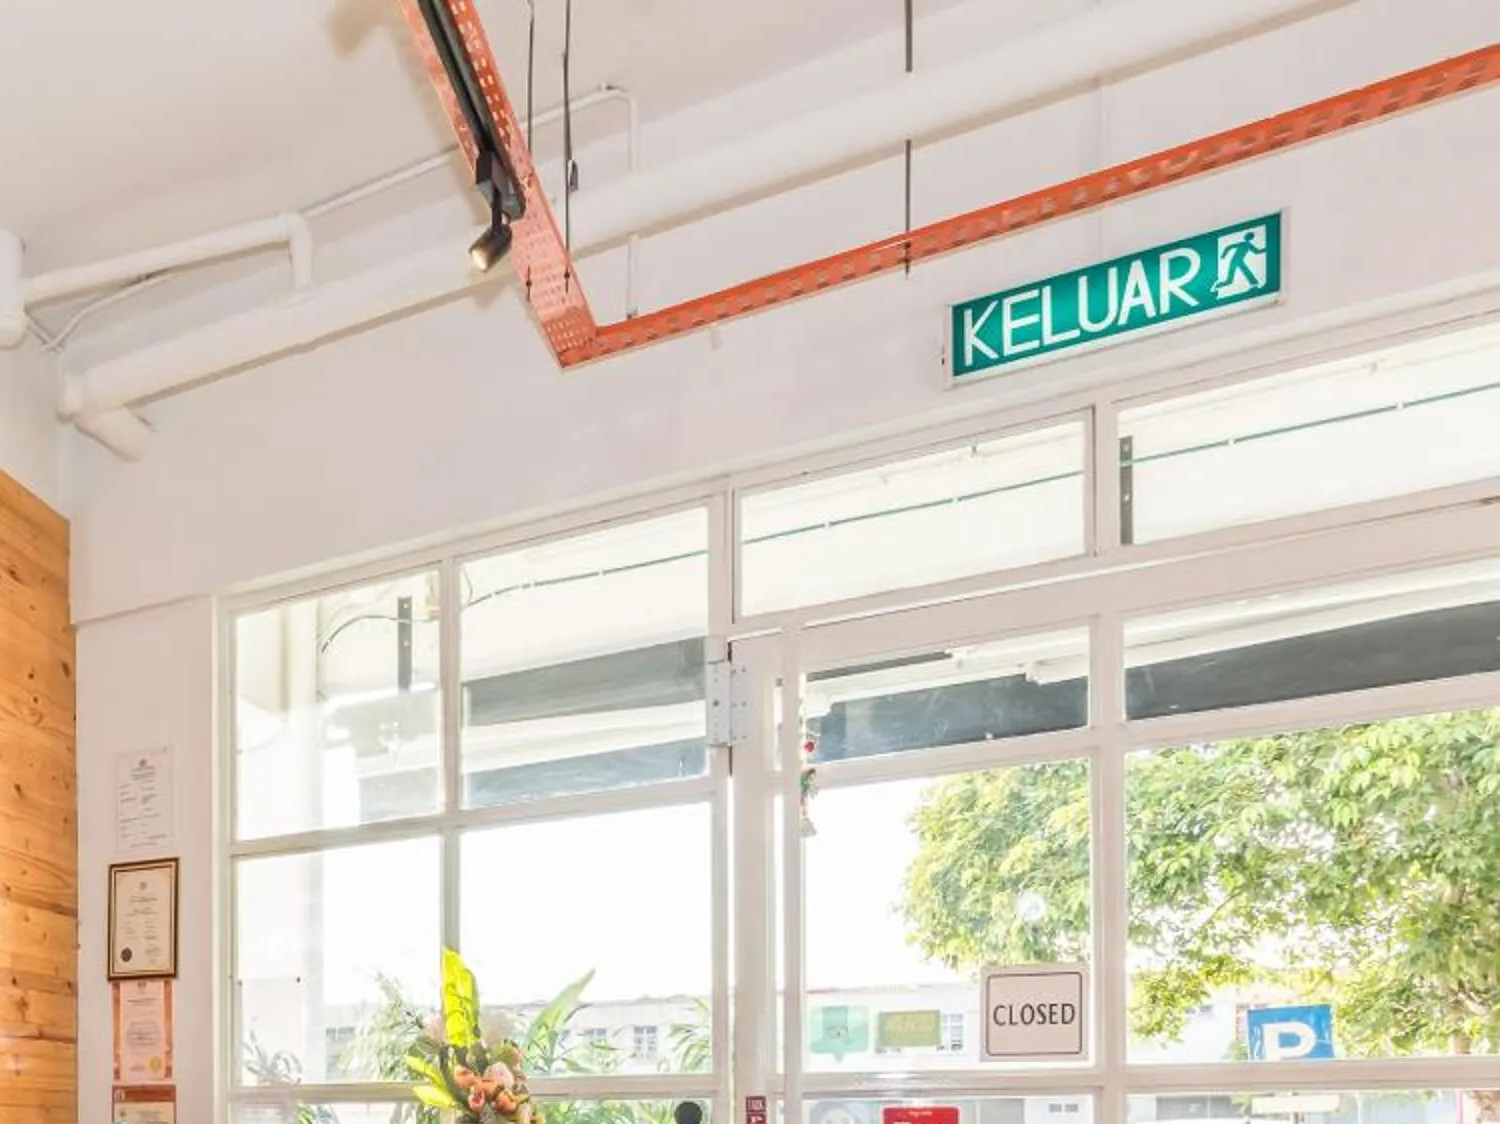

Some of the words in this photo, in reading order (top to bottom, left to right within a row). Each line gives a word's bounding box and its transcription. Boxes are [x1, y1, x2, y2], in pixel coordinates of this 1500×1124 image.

[963, 247, 1201, 366] KELUAR
[993, 1003, 1075, 1026] CLOSED
[1261, 1022, 1317, 1061] P
